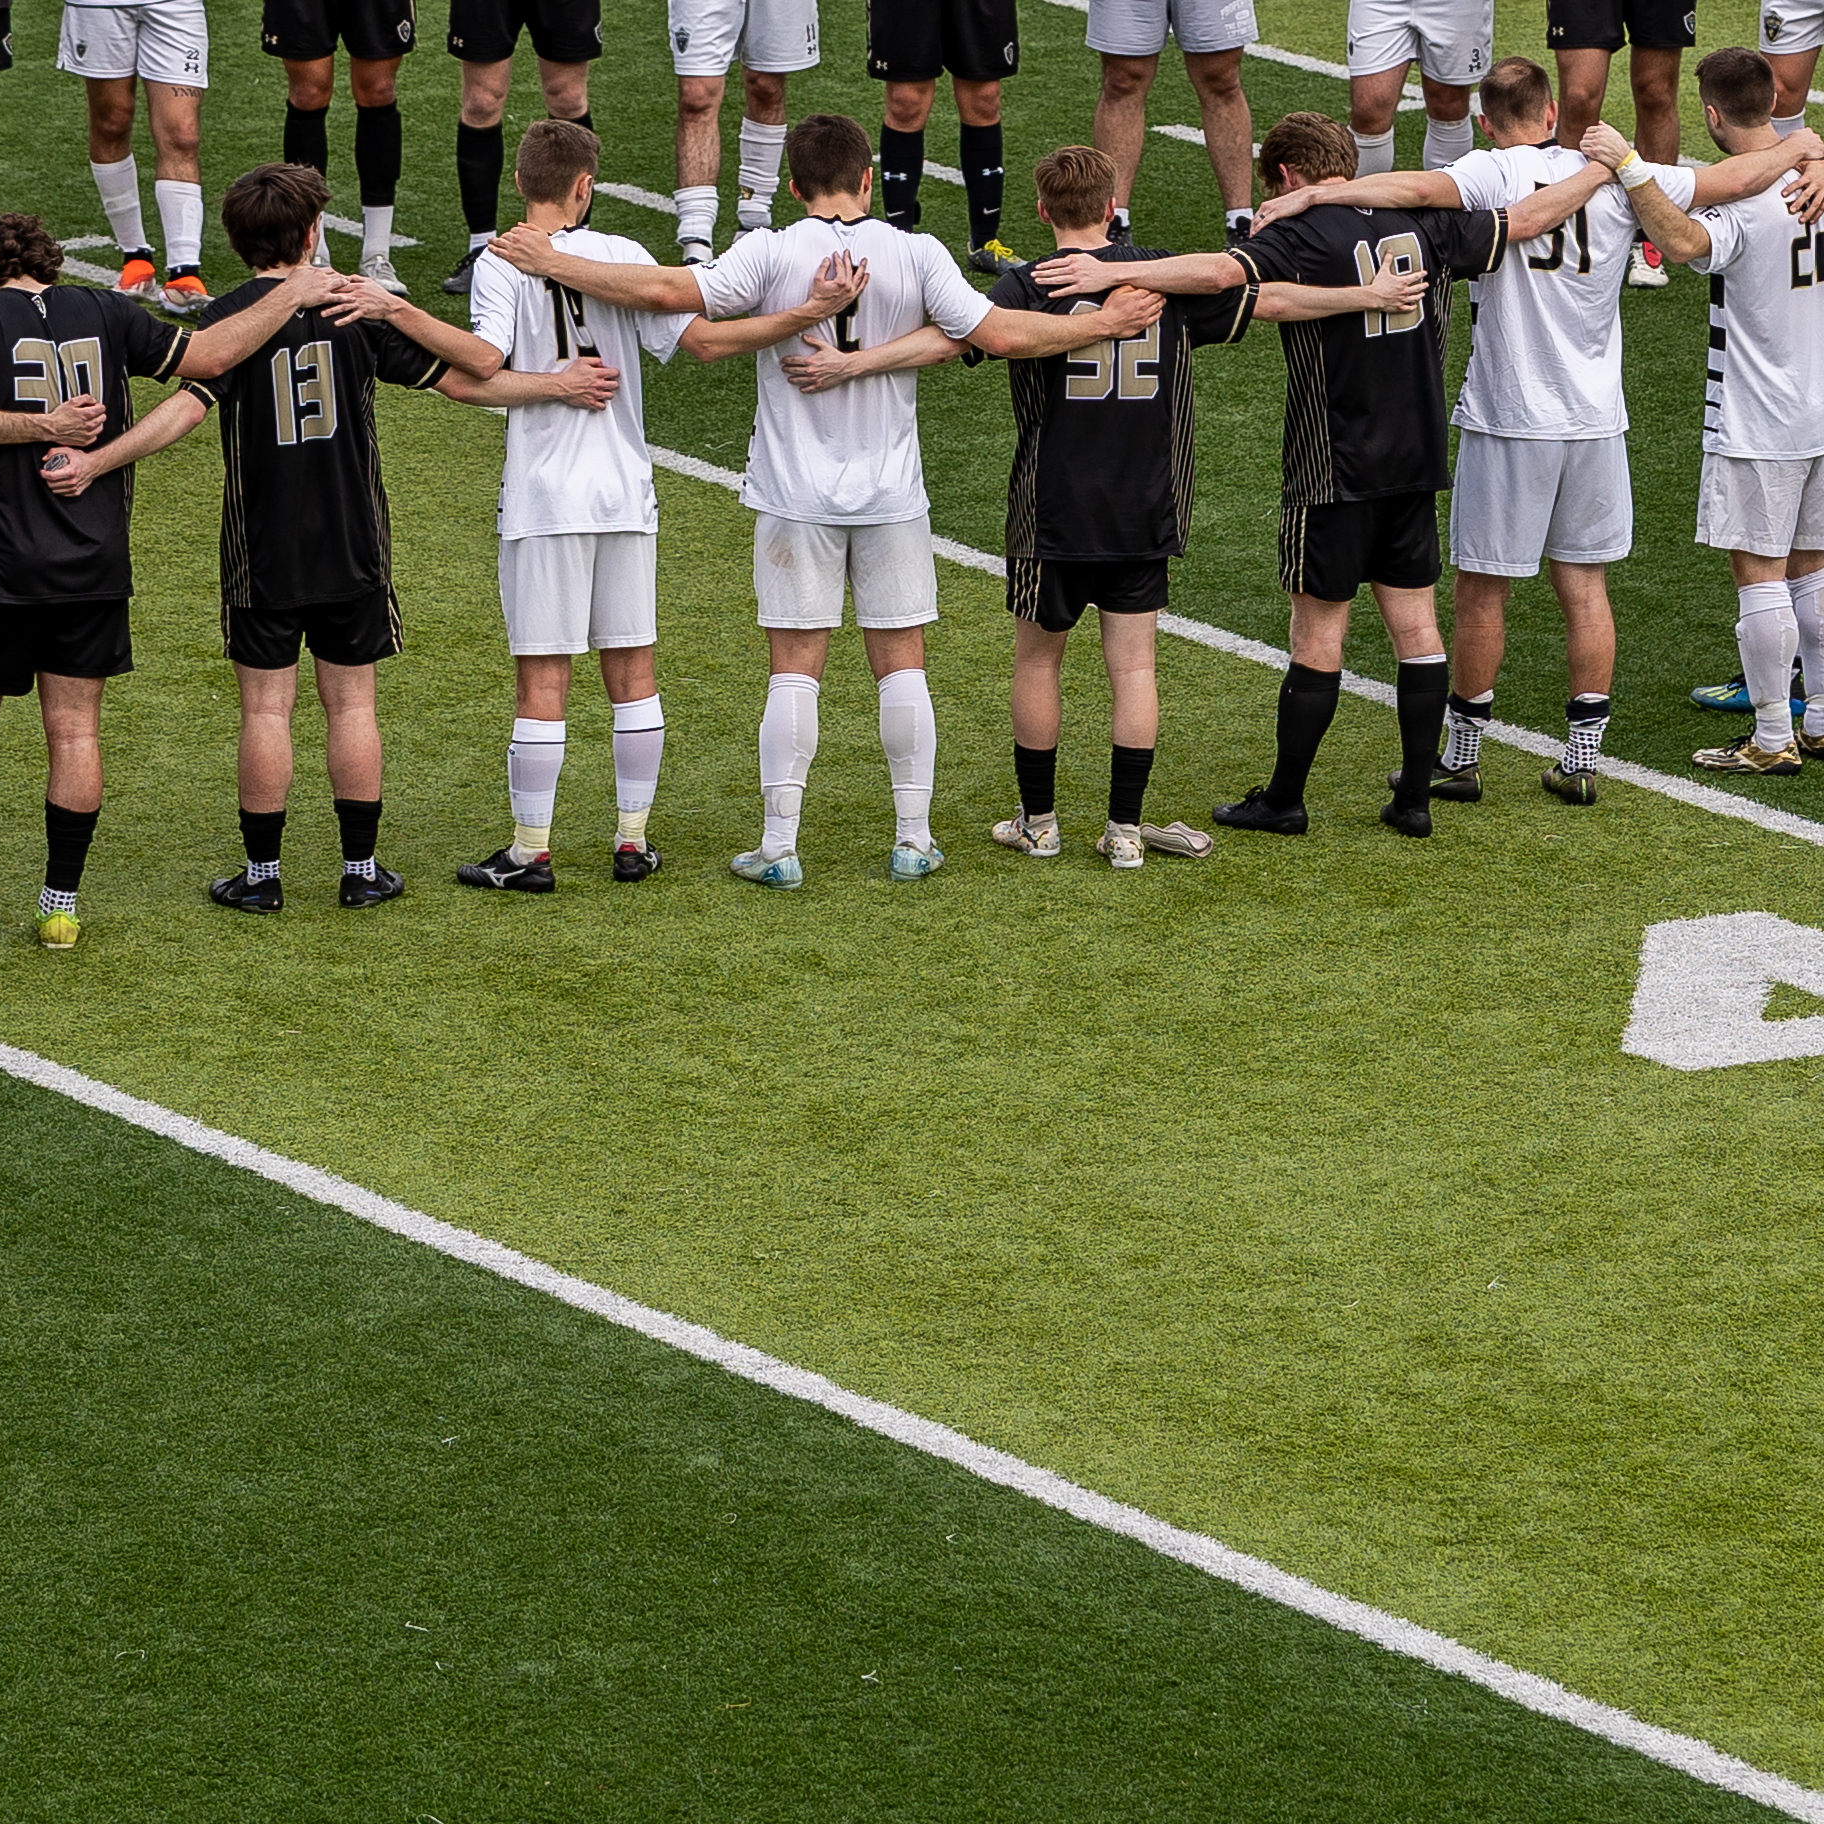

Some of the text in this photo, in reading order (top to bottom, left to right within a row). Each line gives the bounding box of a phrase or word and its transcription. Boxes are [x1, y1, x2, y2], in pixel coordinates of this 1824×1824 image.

[1471, 48, 1480, 63] 3
[13, 336, 103, 414] 30
[271, 340, 338, 445] 13
